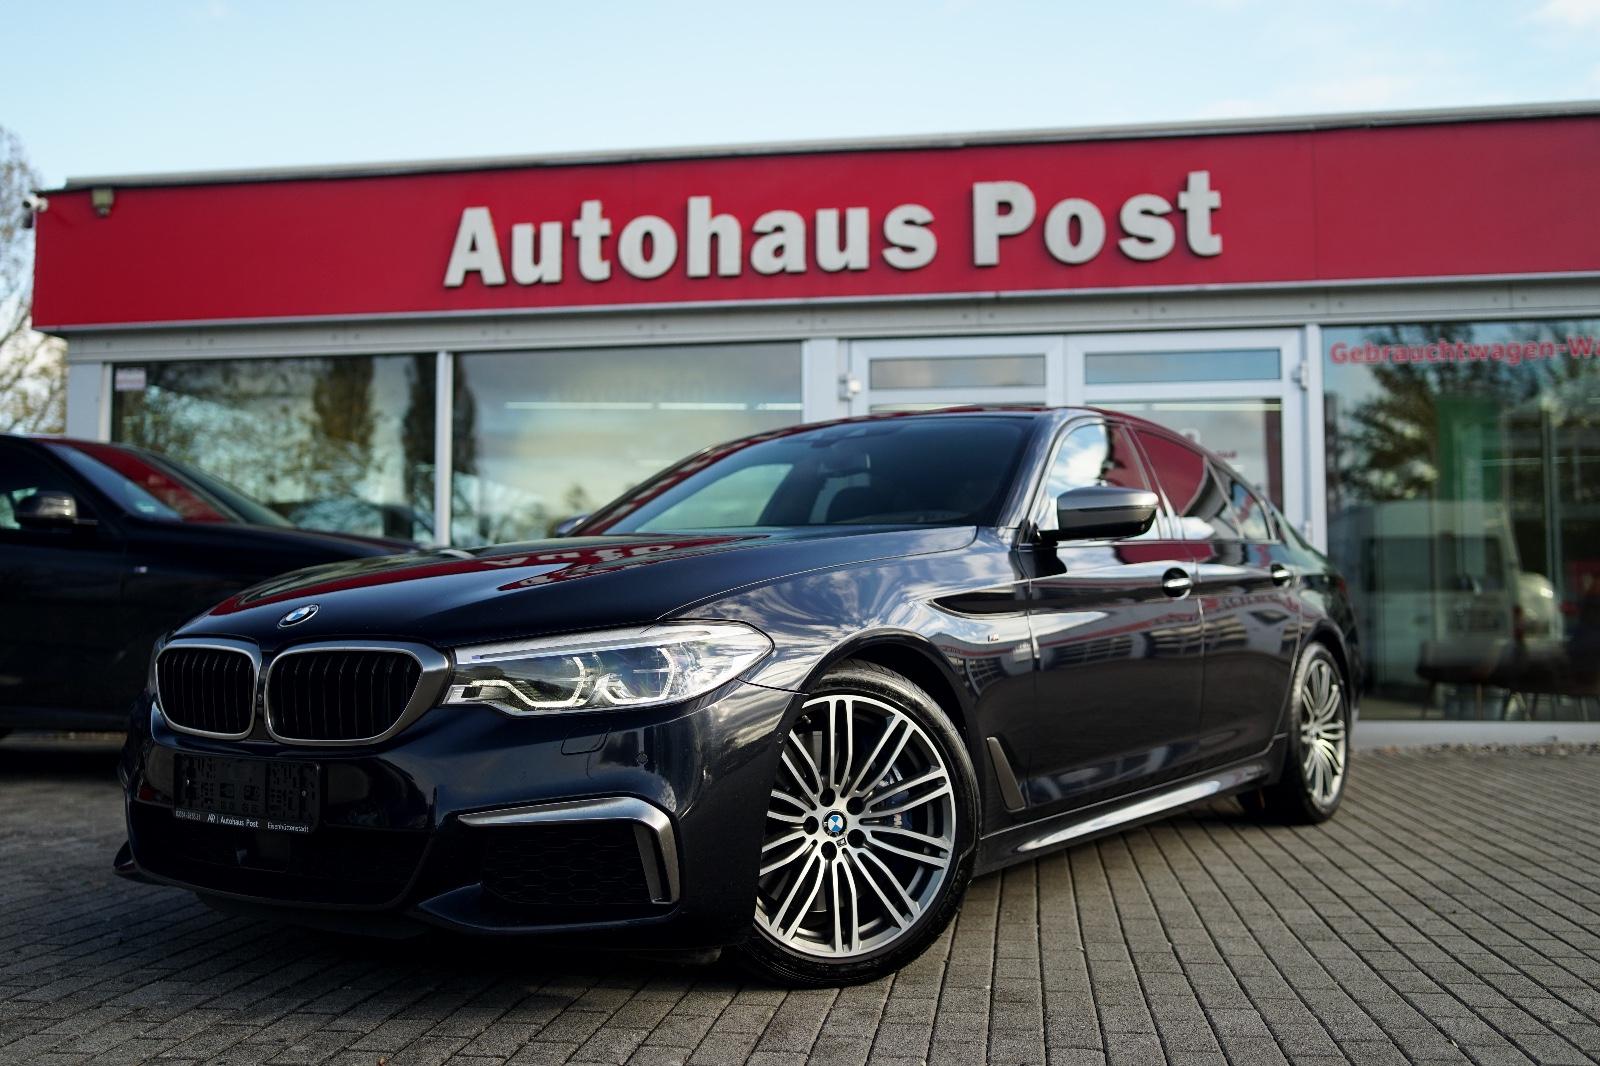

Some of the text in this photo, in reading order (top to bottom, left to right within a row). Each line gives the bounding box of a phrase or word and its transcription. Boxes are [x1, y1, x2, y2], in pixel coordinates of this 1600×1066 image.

[444, 170, 1223, 287] Autohaus Post
[1329, 336, 1600, 365] Gebrauchtwagen-W
[220, 816, 244, 827] Autohaus
[246, 819, 259, 828] Post
